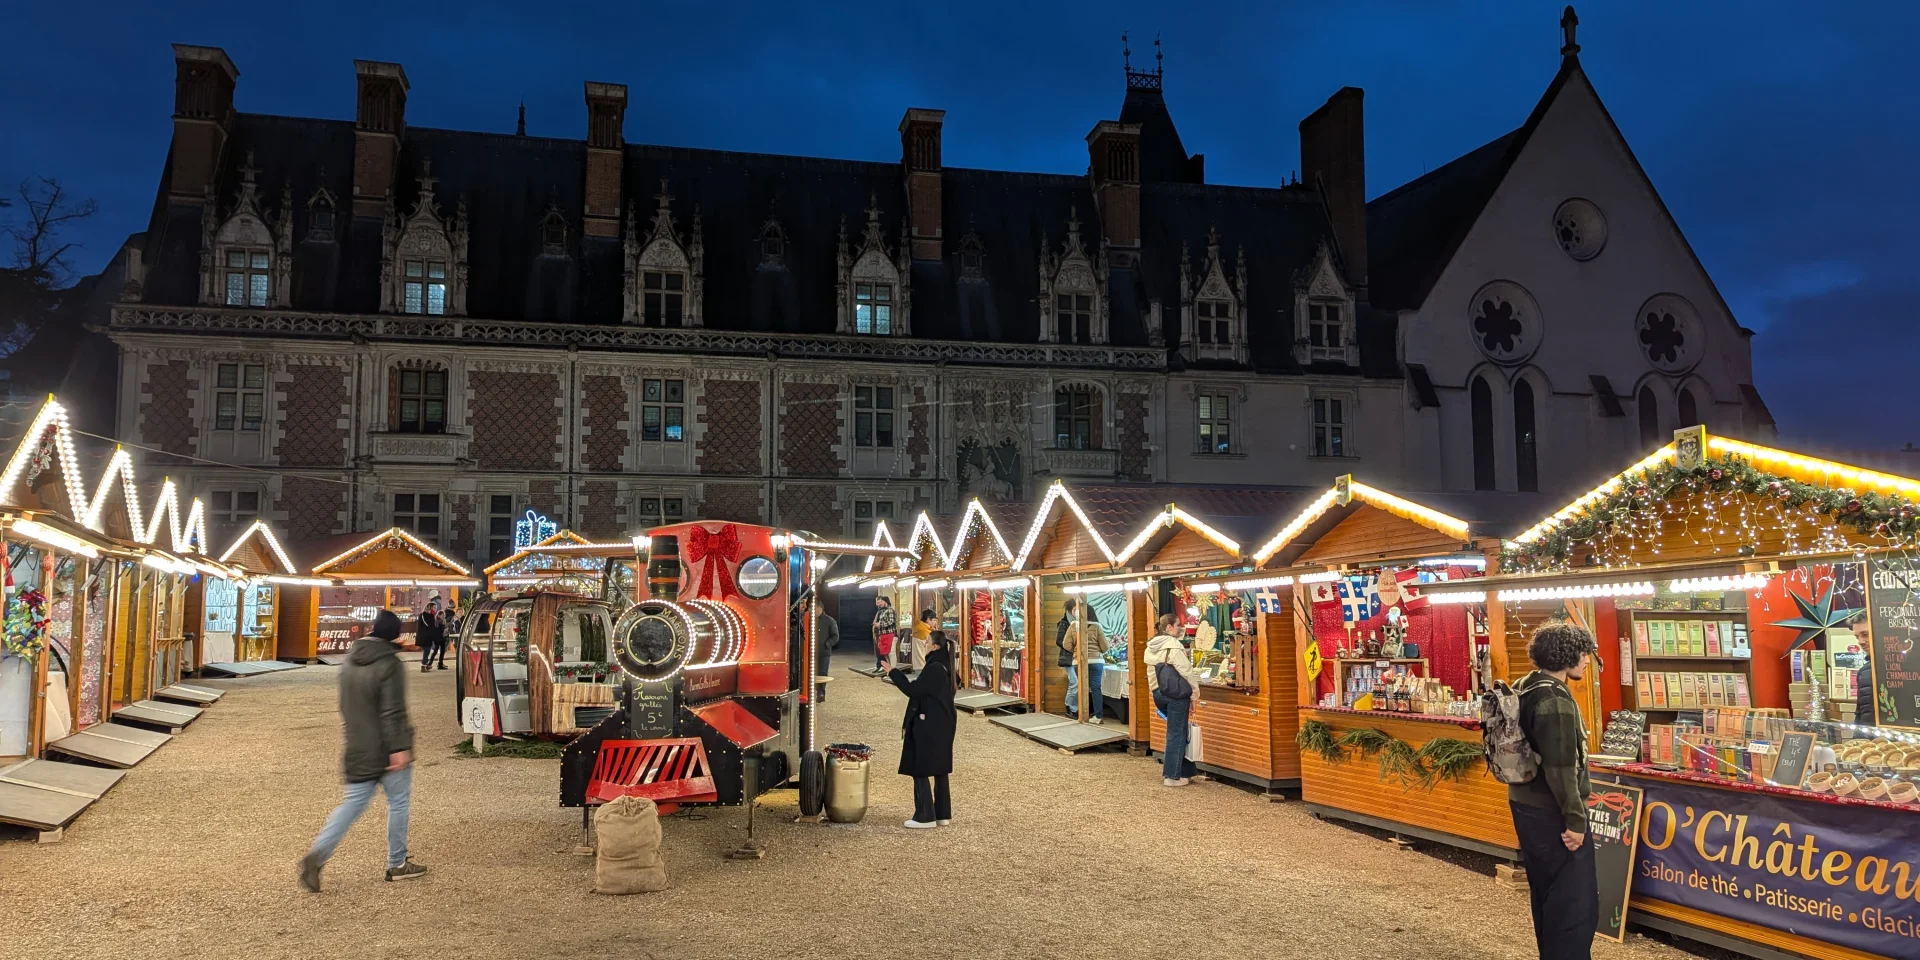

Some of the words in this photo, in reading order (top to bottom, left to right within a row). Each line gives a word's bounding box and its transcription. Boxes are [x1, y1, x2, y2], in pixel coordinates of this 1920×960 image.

[556, 560, 568, 569] DE
[320, 630, 350, 638] BRETZEL
[661, 607, 686, 659] MARRONS
[318, 639, 337, 650] SALÉ
[338, 641, 345, 650] &
[345, 641, 354, 650] S
[1885, 663, 1902, 671] LION
[1886, 680, 1904, 689] DAIM
[1641, 859, 1684, 885] Salon
[1688, 868, 1708, 891] de
[1711, 874, 1739, 898] thé
[1755, 883, 1843, 921] Patisserie
